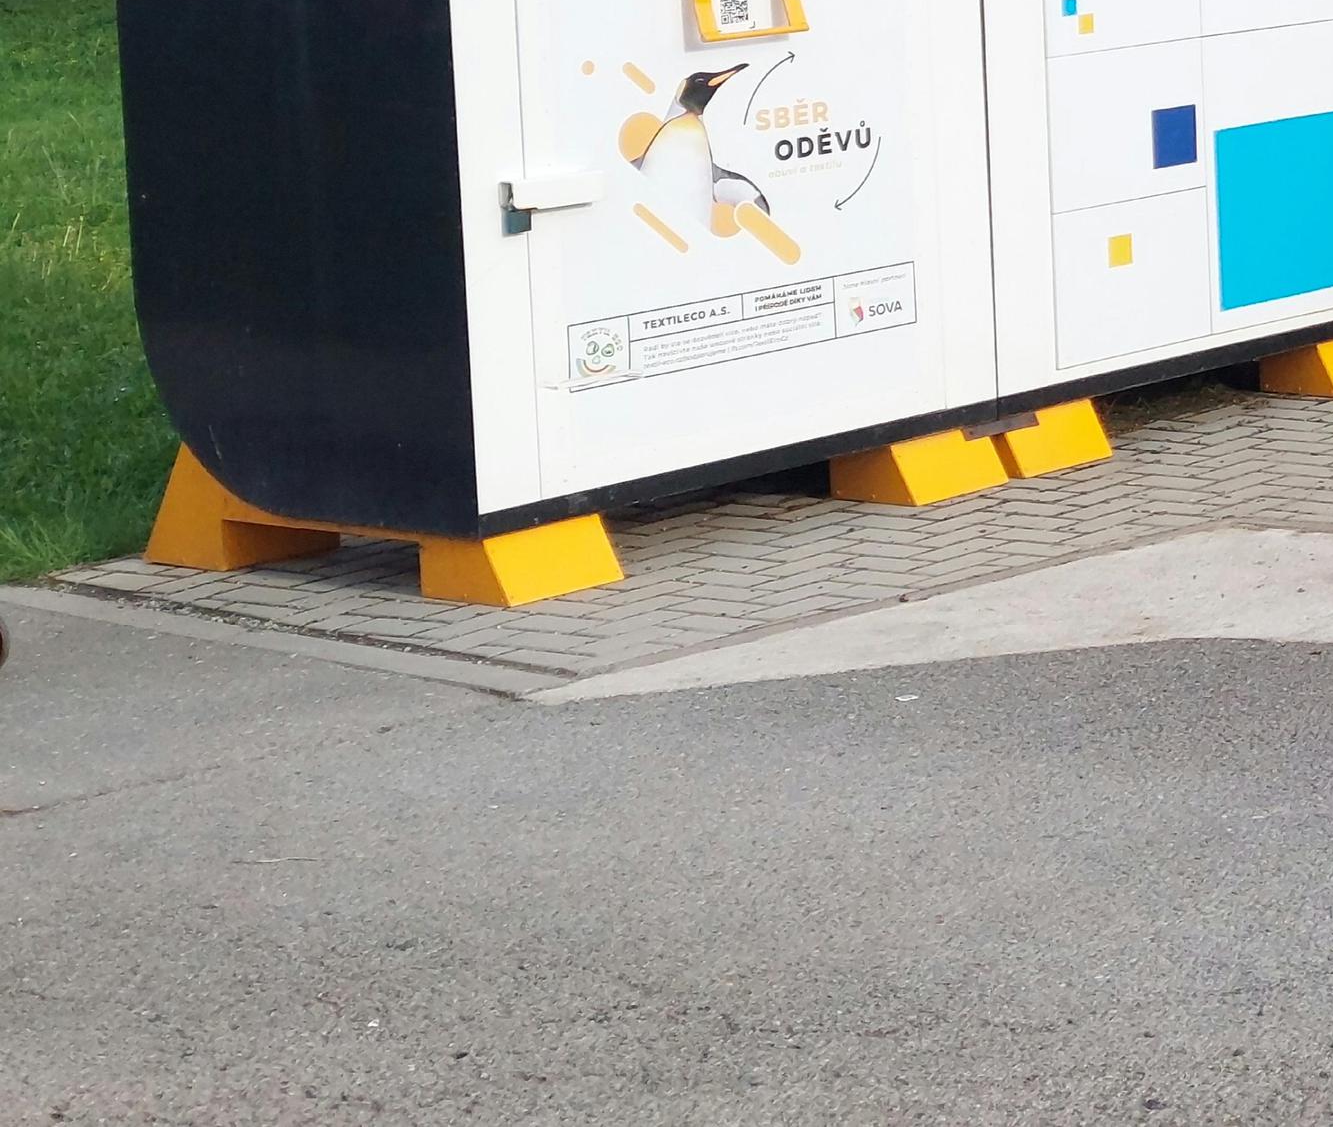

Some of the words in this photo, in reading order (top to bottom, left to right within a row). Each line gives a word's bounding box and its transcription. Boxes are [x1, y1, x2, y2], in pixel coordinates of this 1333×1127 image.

[755, 98, 829, 131] SBĚR
[774, 120, 871, 161] ODĚVŮ
[642, 310, 706, 330] TEXTILECO
[709, 306, 731, 318] A.S.
[868, 300, 903, 318] SOVA
